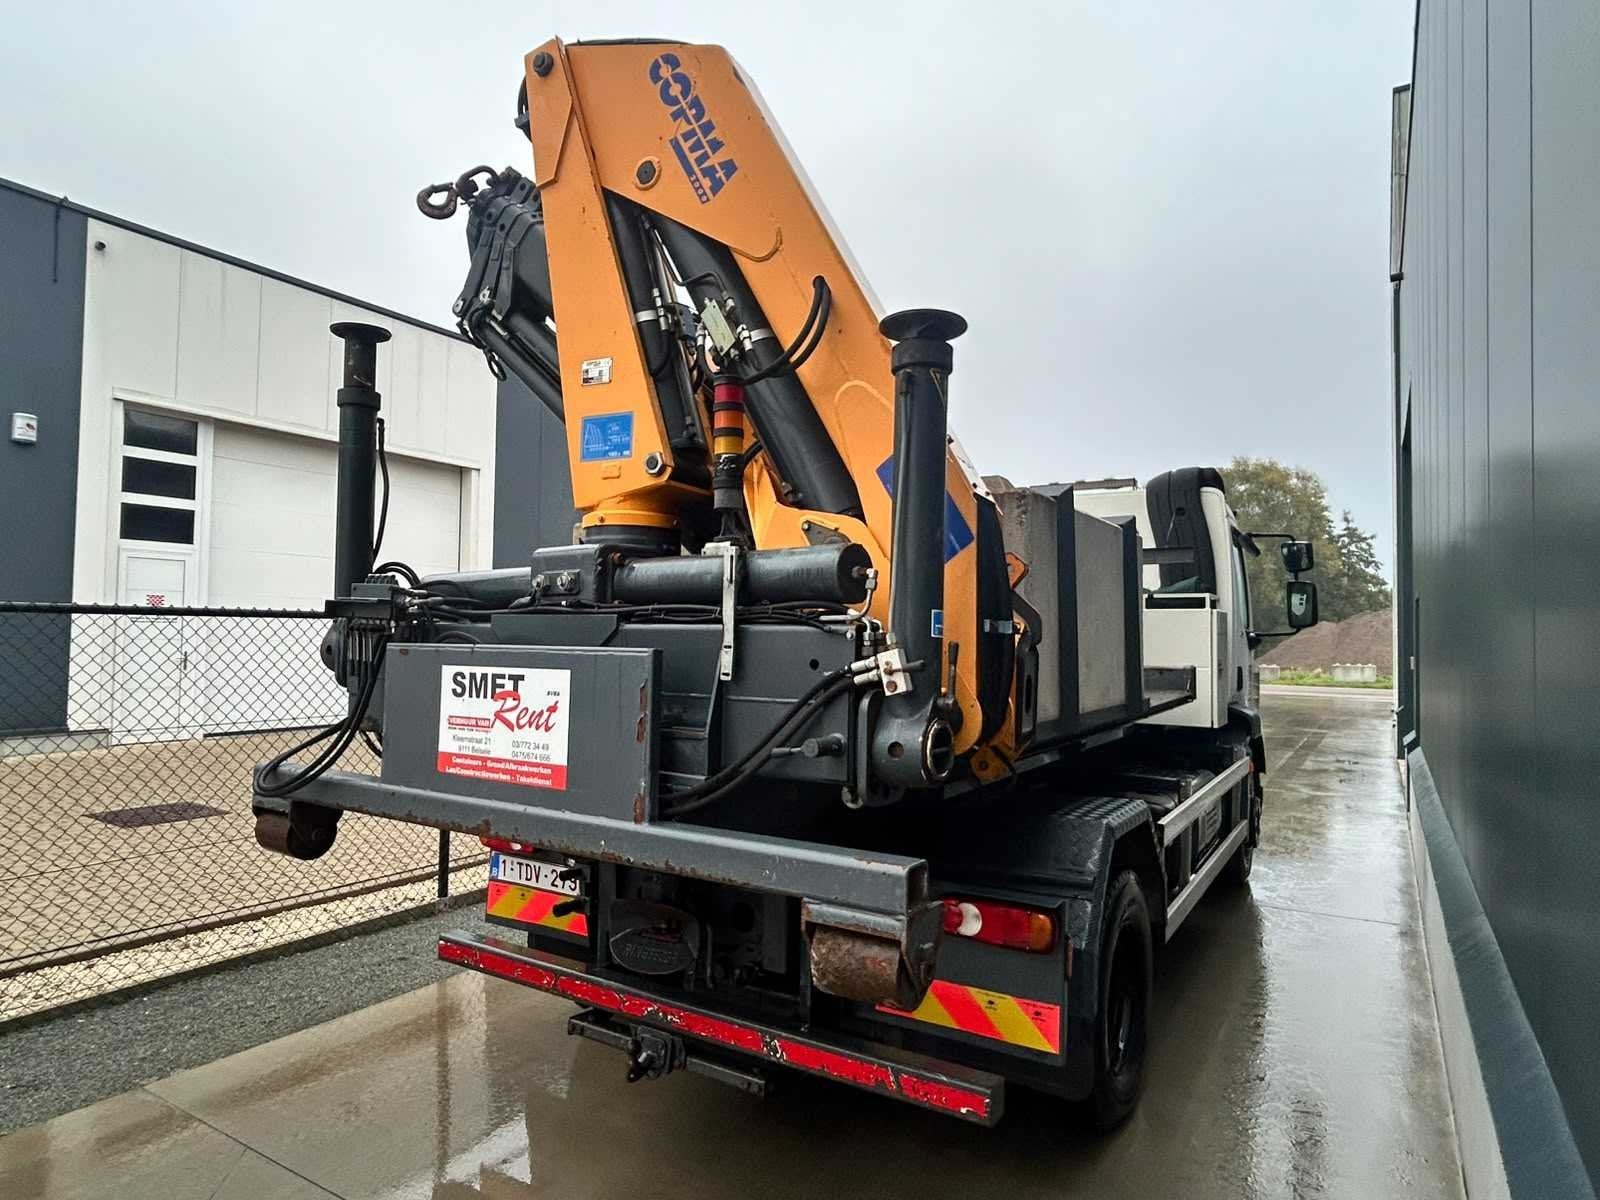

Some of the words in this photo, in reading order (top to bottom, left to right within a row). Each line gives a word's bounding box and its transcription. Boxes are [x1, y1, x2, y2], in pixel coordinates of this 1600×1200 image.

[649, 53, 738, 197] COPMA
[452, 672, 525, 700] SMET
[490, 690, 560, 733] Rent
[492, 867, 498, 876] B
